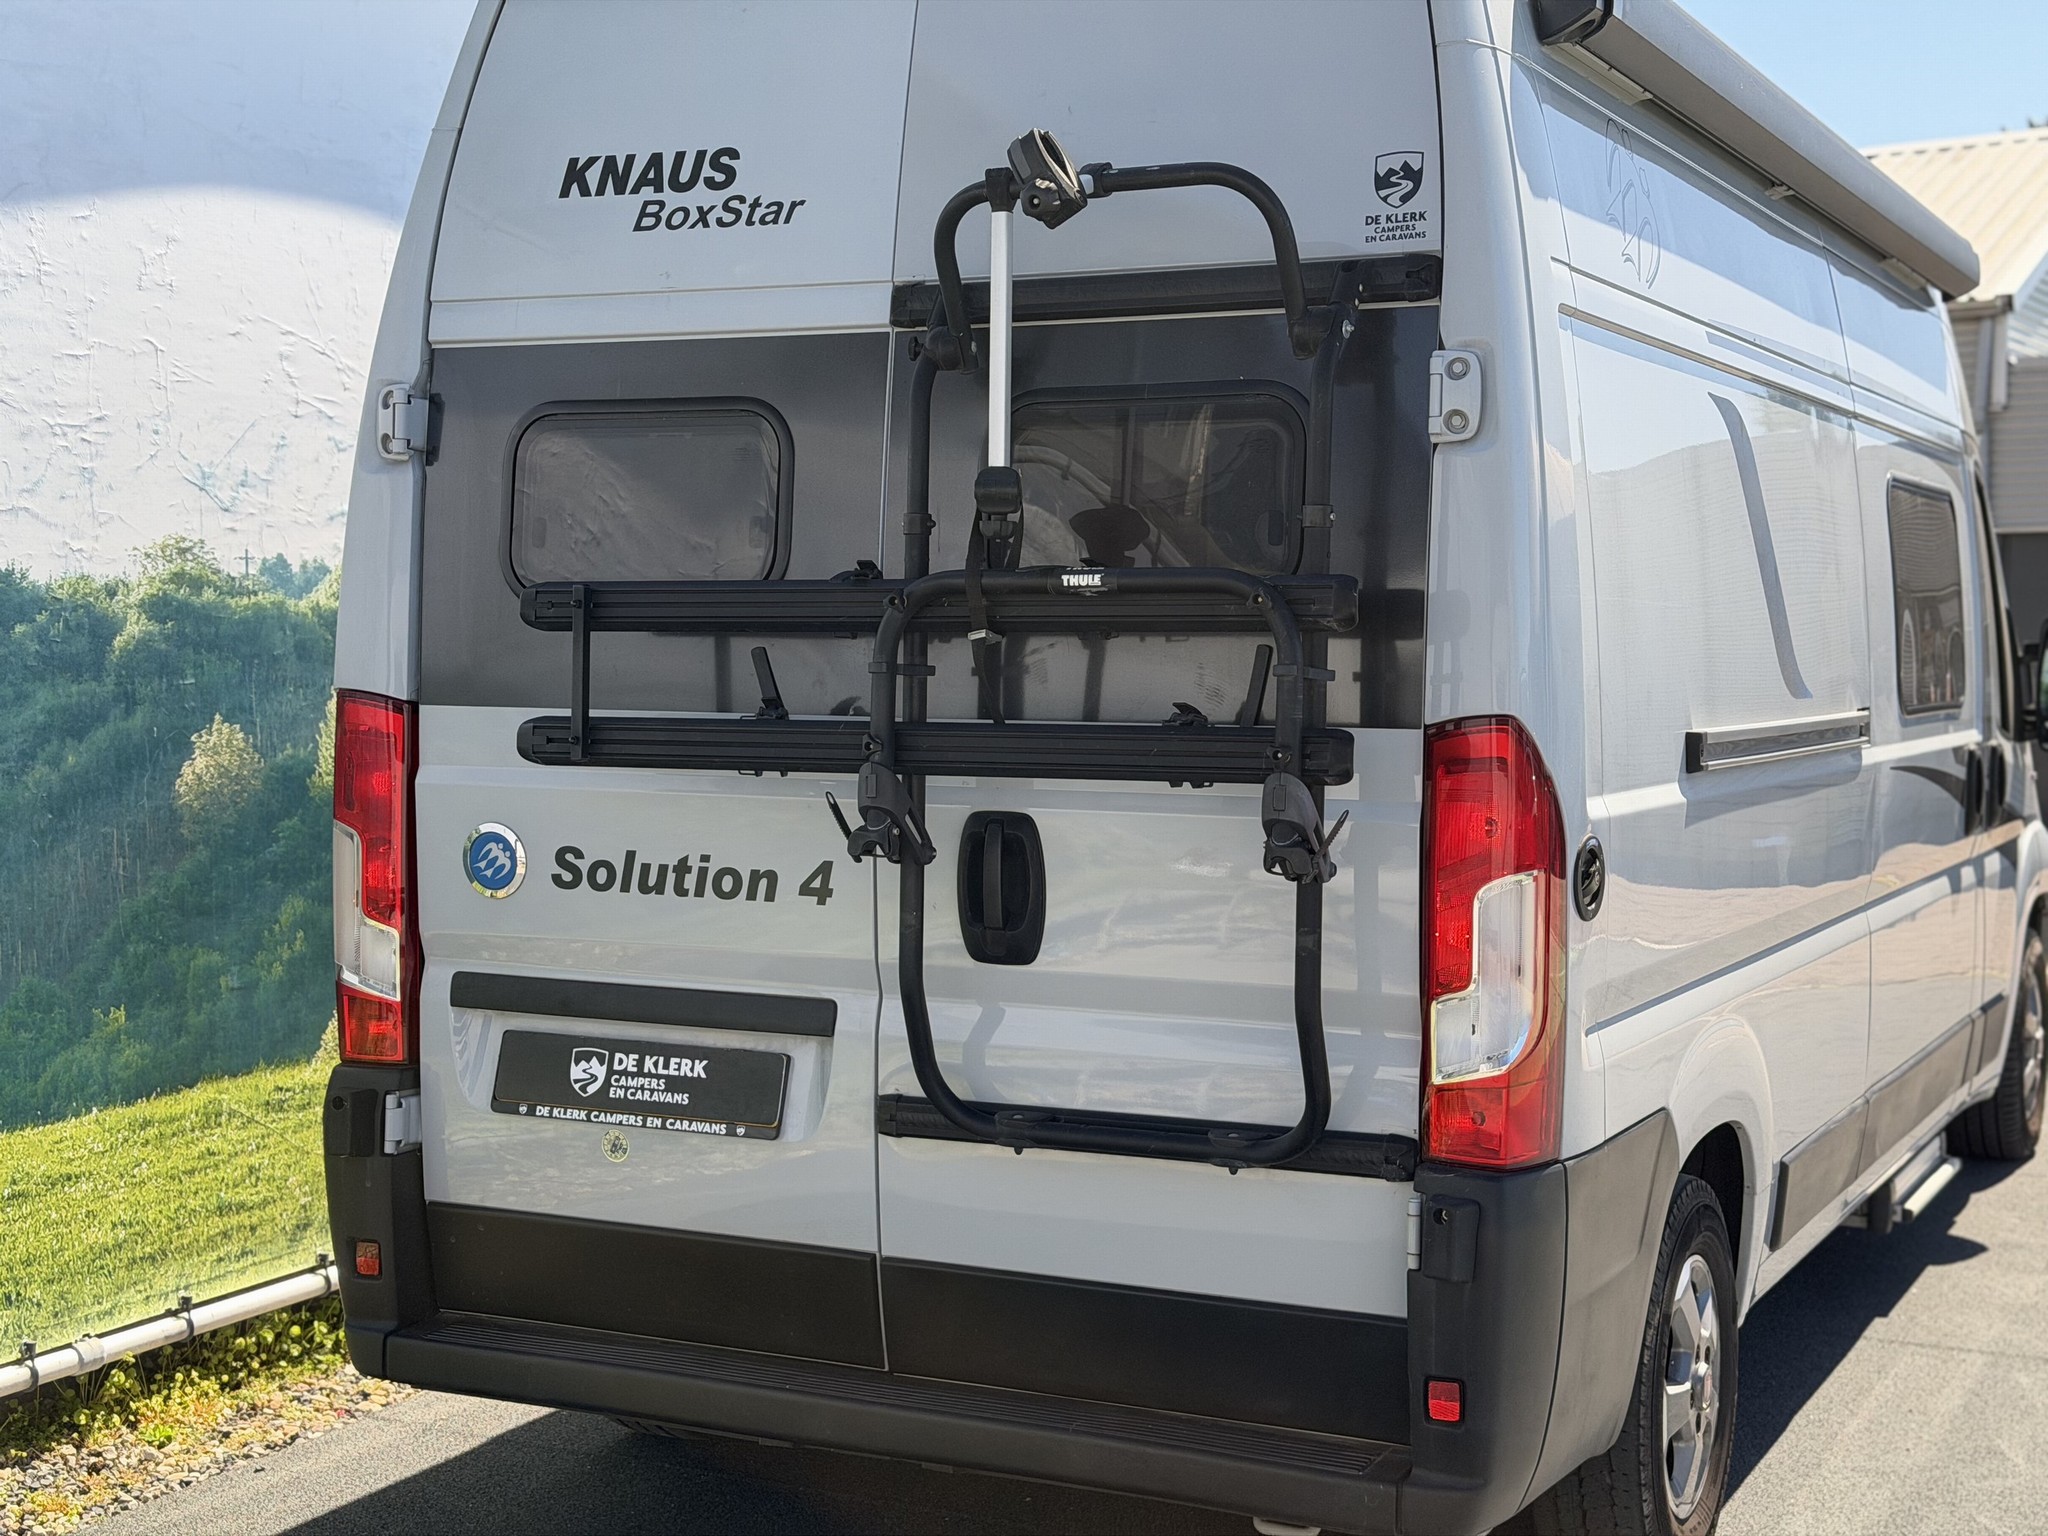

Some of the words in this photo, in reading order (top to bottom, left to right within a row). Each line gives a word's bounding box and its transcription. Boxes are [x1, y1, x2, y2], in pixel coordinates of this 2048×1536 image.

[558, 147, 741, 199] KNAUS
[632, 194, 806, 232] BoxStar
[1365, 215, 1381, 226] DE
[1386, 211, 1427, 224] KLERK
[1365, 235, 1377, 243] EN
[1379, 231, 1427, 242] CARAVANS
[1374, 224, 1416, 234] CAMPERS
[1061, 574, 1102, 586] THULE
[551, 845, 779, 903] Solution
[798, 860, 834, 906] 4
[613, 1052, 639, 1072] DE
[643, 1055, 709, 1078] KLERK
[611, 1075, 665, 1090] CAMPERS
[609, 1087, 625, 1100] EN
[626, 1089, 689, 1104] CARAVANS
[535, 1106, 551, 1117] DE
[552, 1107, 587, 1120] KLERK
[590, 1111, 643, 1126] CAMPERS
[646, 1116, 661, 1128] EN
[665, 1119, 727, 1134] CARAVANS
